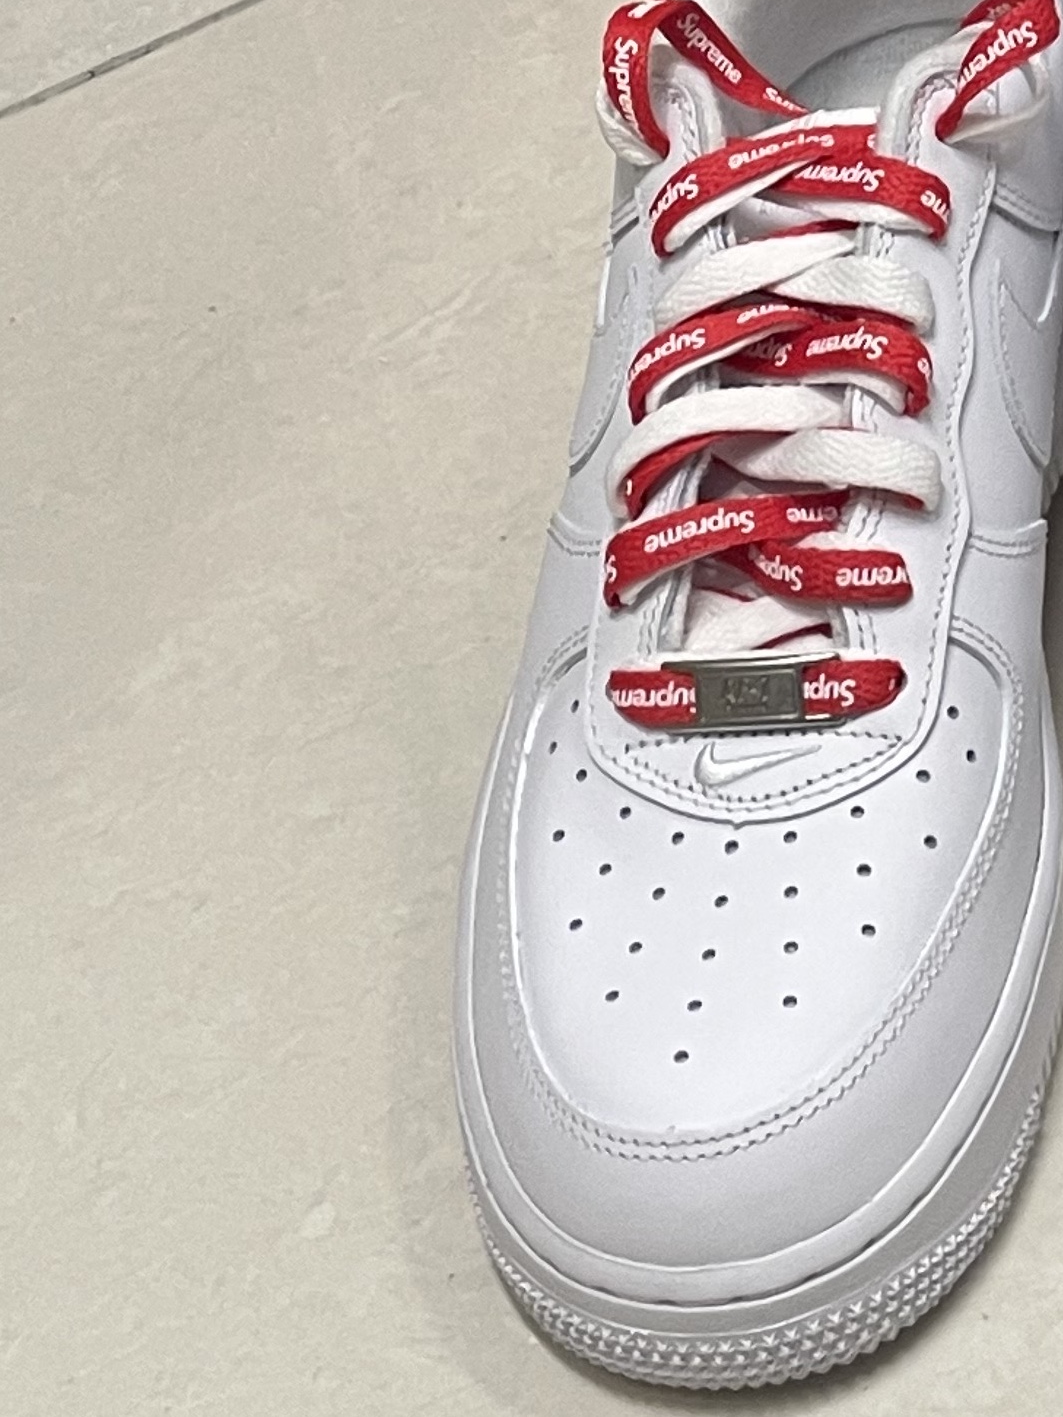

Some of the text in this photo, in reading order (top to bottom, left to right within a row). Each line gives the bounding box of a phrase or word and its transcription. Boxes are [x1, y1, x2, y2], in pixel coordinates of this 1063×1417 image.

[672, 12, 743, 84] Supreme
[806, 325, 889, 361] Supreme
[643, 507, 757, 554] Supreme
